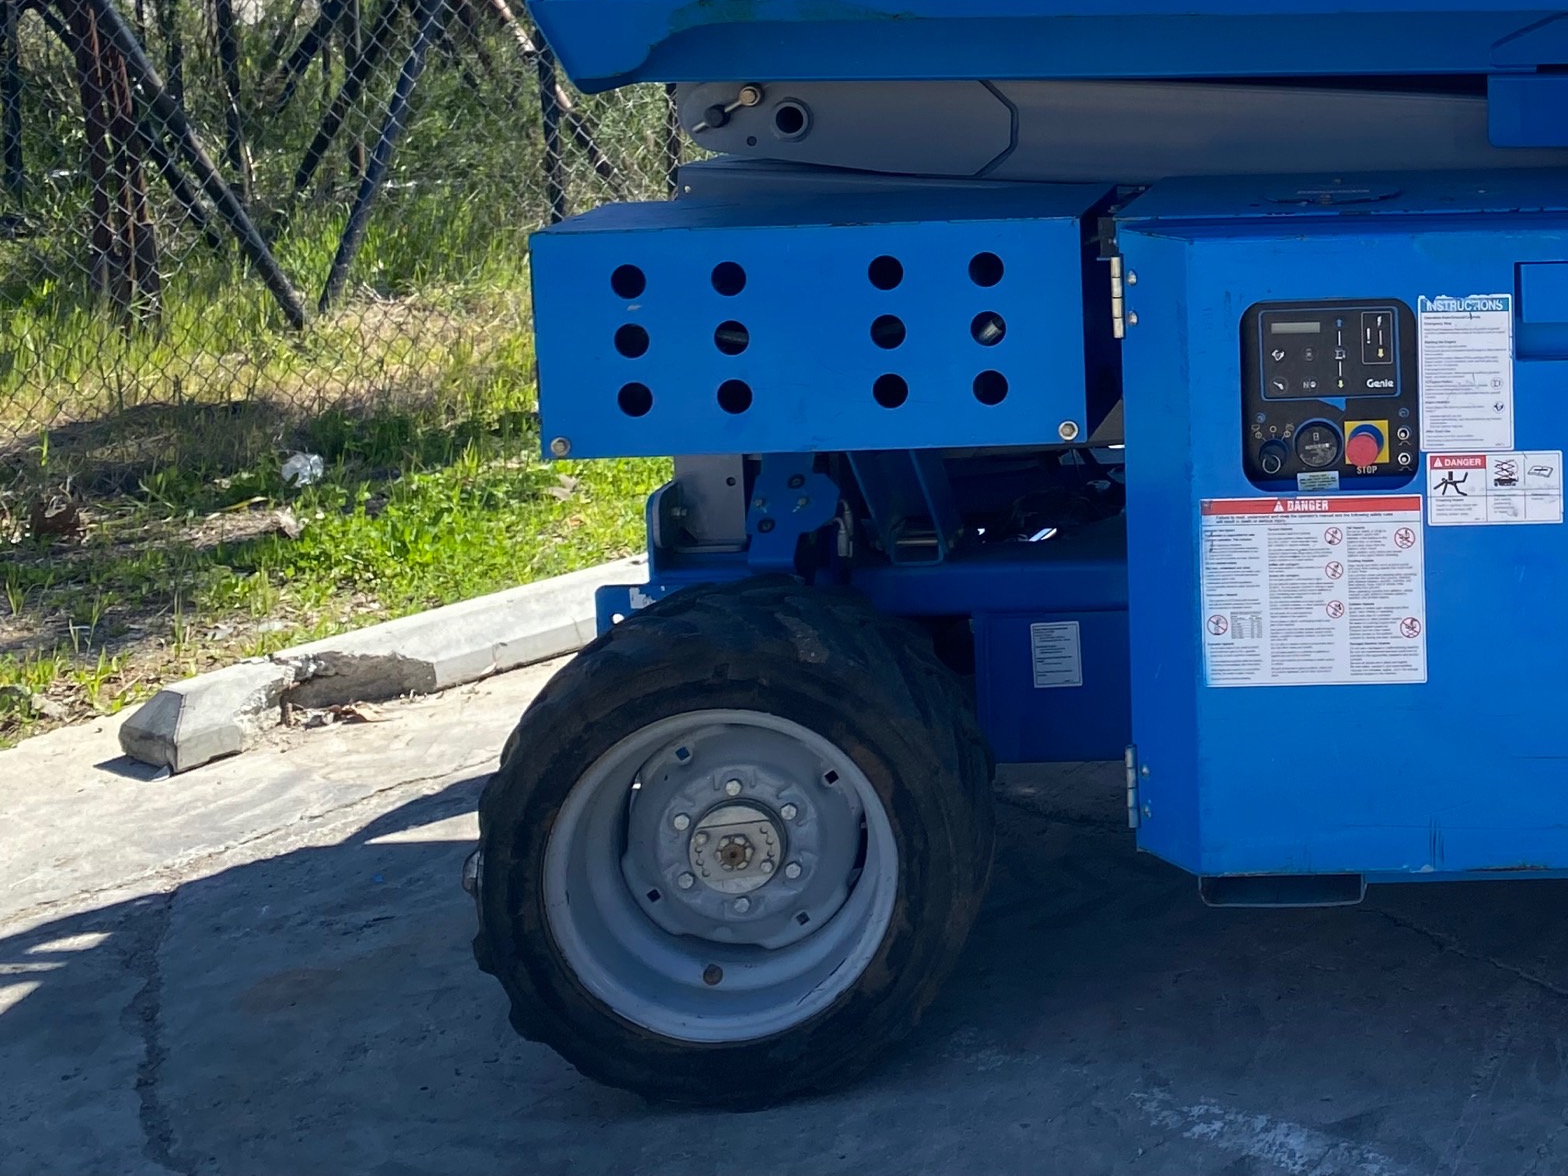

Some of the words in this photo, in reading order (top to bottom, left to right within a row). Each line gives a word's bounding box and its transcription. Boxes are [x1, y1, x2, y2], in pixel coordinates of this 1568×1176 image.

[1366, 378, 1394, 389] Genie
[1444, 457, 1482, 467] DANGER
[1356, 465, 1378, 475] STOP
[1286, 499, 1329, 512] DANGER
